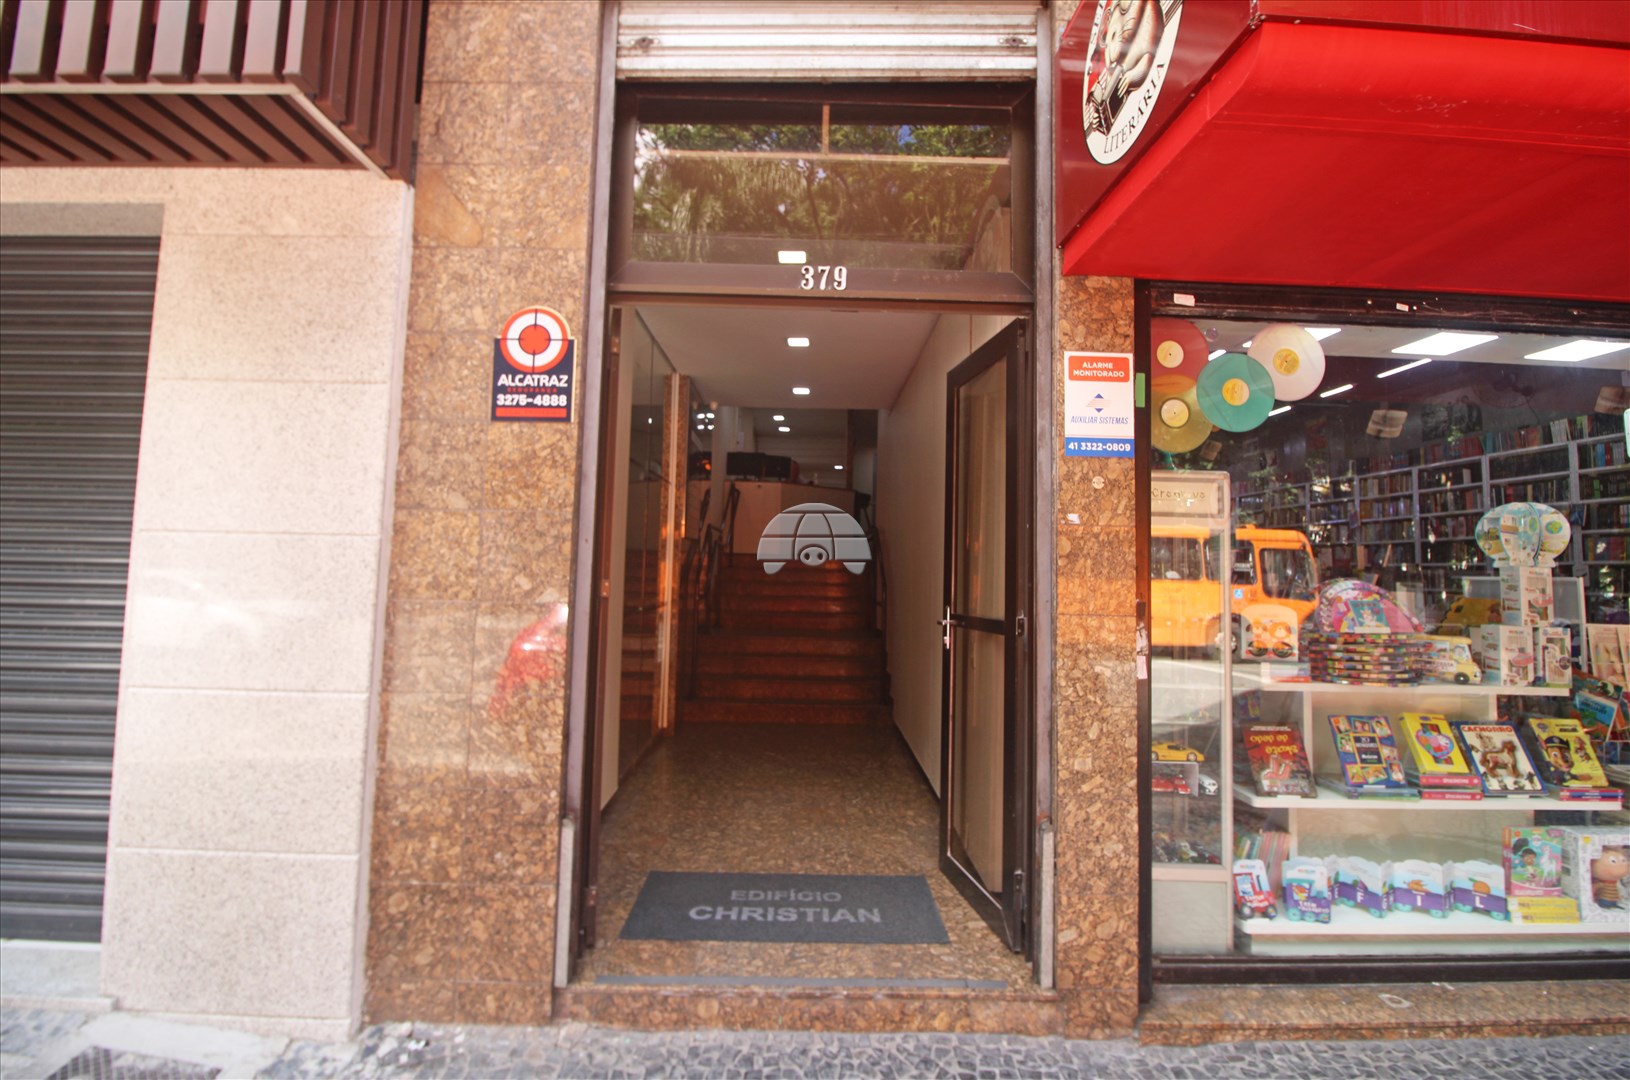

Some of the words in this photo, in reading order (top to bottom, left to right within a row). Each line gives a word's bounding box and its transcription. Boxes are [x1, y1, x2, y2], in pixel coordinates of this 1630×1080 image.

[801, 265, 847, 290] 379
[1082, 361, 1113, 369] ALARME
[497, 373, 568, 387] ALCATRAZ
[1073, 369, 1125, 378] MONITORADO
[496, 393, 567, 406] 3275-4888
[1071, 415, 1098, 424] AUXILIAR
[1099, 416, 1129, 425] SISTEMAS
[1068, 442, 1078, 450] 41
[1080, 442, 1131, 451] 3322-0809
[730, 889, 842, 902] EDIFÍCIO
[689, 906, 881, 922] CHRISTIAN
